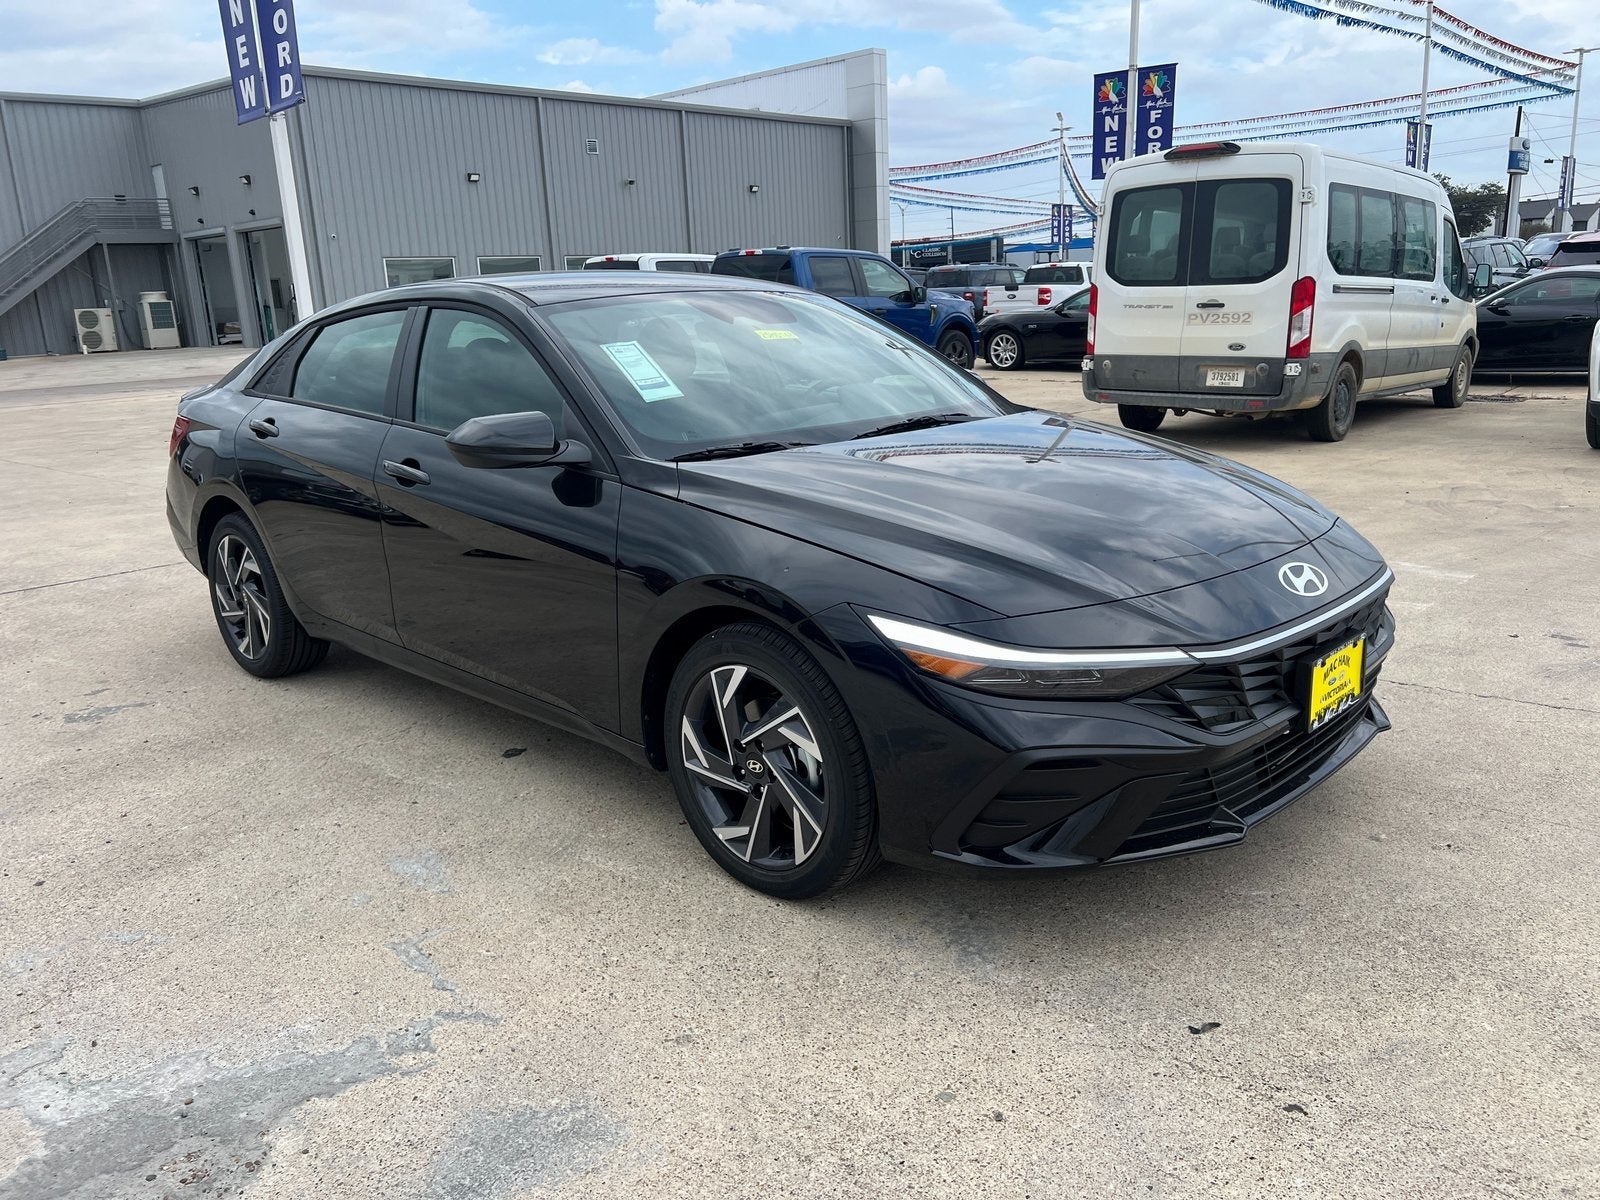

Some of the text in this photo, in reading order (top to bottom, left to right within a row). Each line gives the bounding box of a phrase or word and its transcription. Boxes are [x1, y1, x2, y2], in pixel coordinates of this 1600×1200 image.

[229, 0, 256, 109] NEW
[272, 0, 294, 99] ORD
[1147, 109, 1163, 154] FOR
[1187, 312, 1252, 325] PV2592
